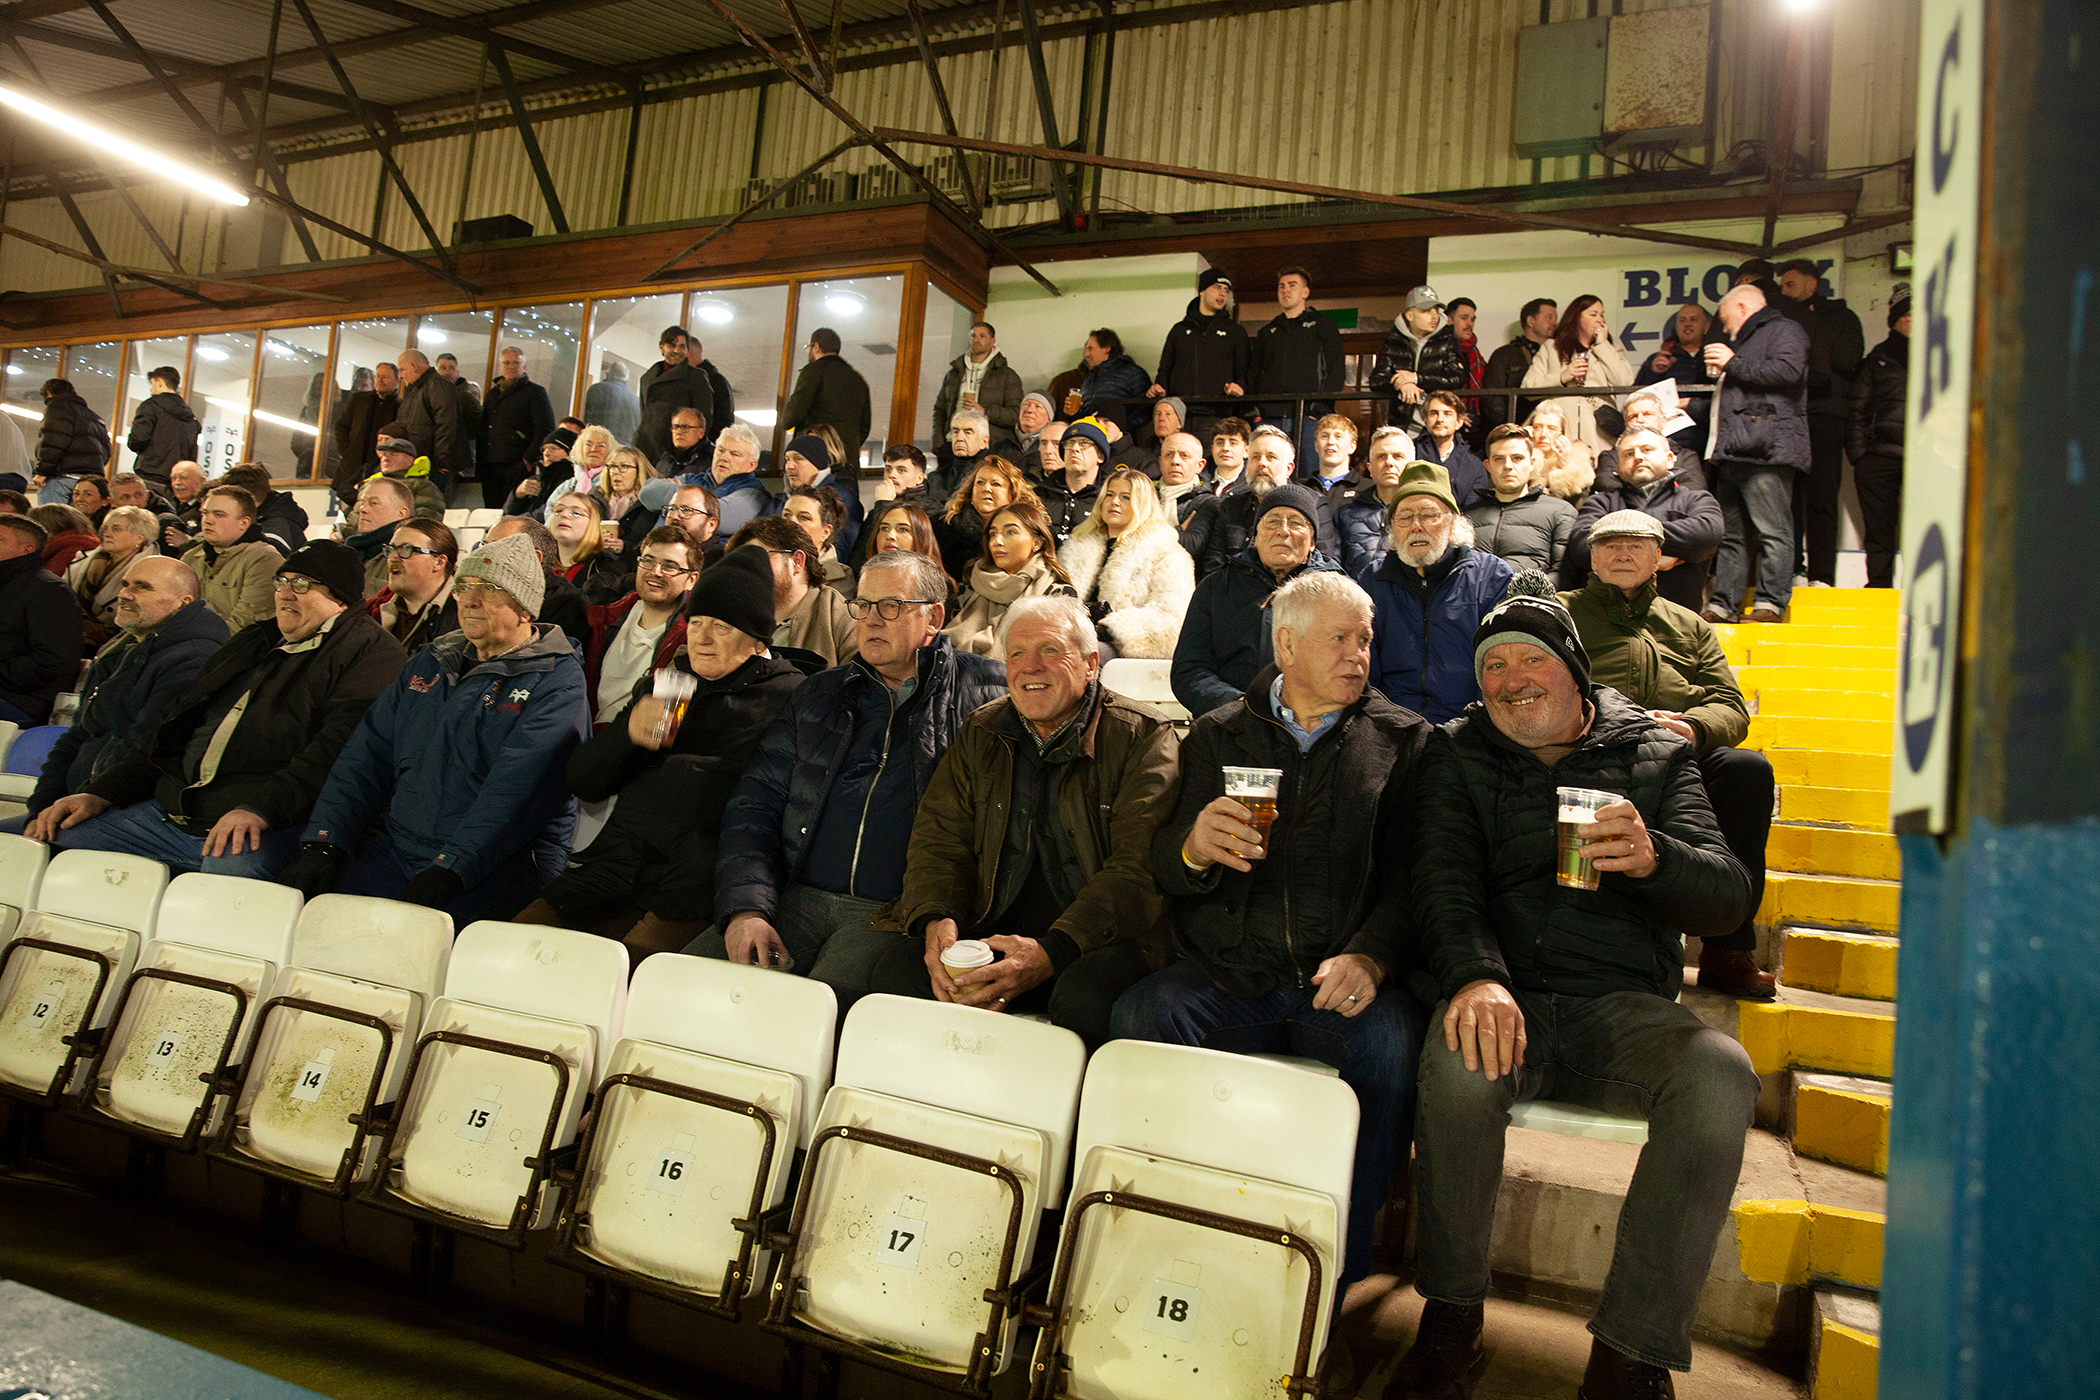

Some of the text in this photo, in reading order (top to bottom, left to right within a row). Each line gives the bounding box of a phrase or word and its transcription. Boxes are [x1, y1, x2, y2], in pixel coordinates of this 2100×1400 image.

[1623, 259, 1835, 308] BLO
[33, 1003, 49, 1018] 12
[156, 1041, 174, 1056] 13
[302, 1071, 322, 1088] 14
[467, 1109, 490, 1128] 15
[659, 1159, 684, 1180] 16
[888, 1230, 915, 1252] 17
[1157, 1296, 1189, 1322] 18
